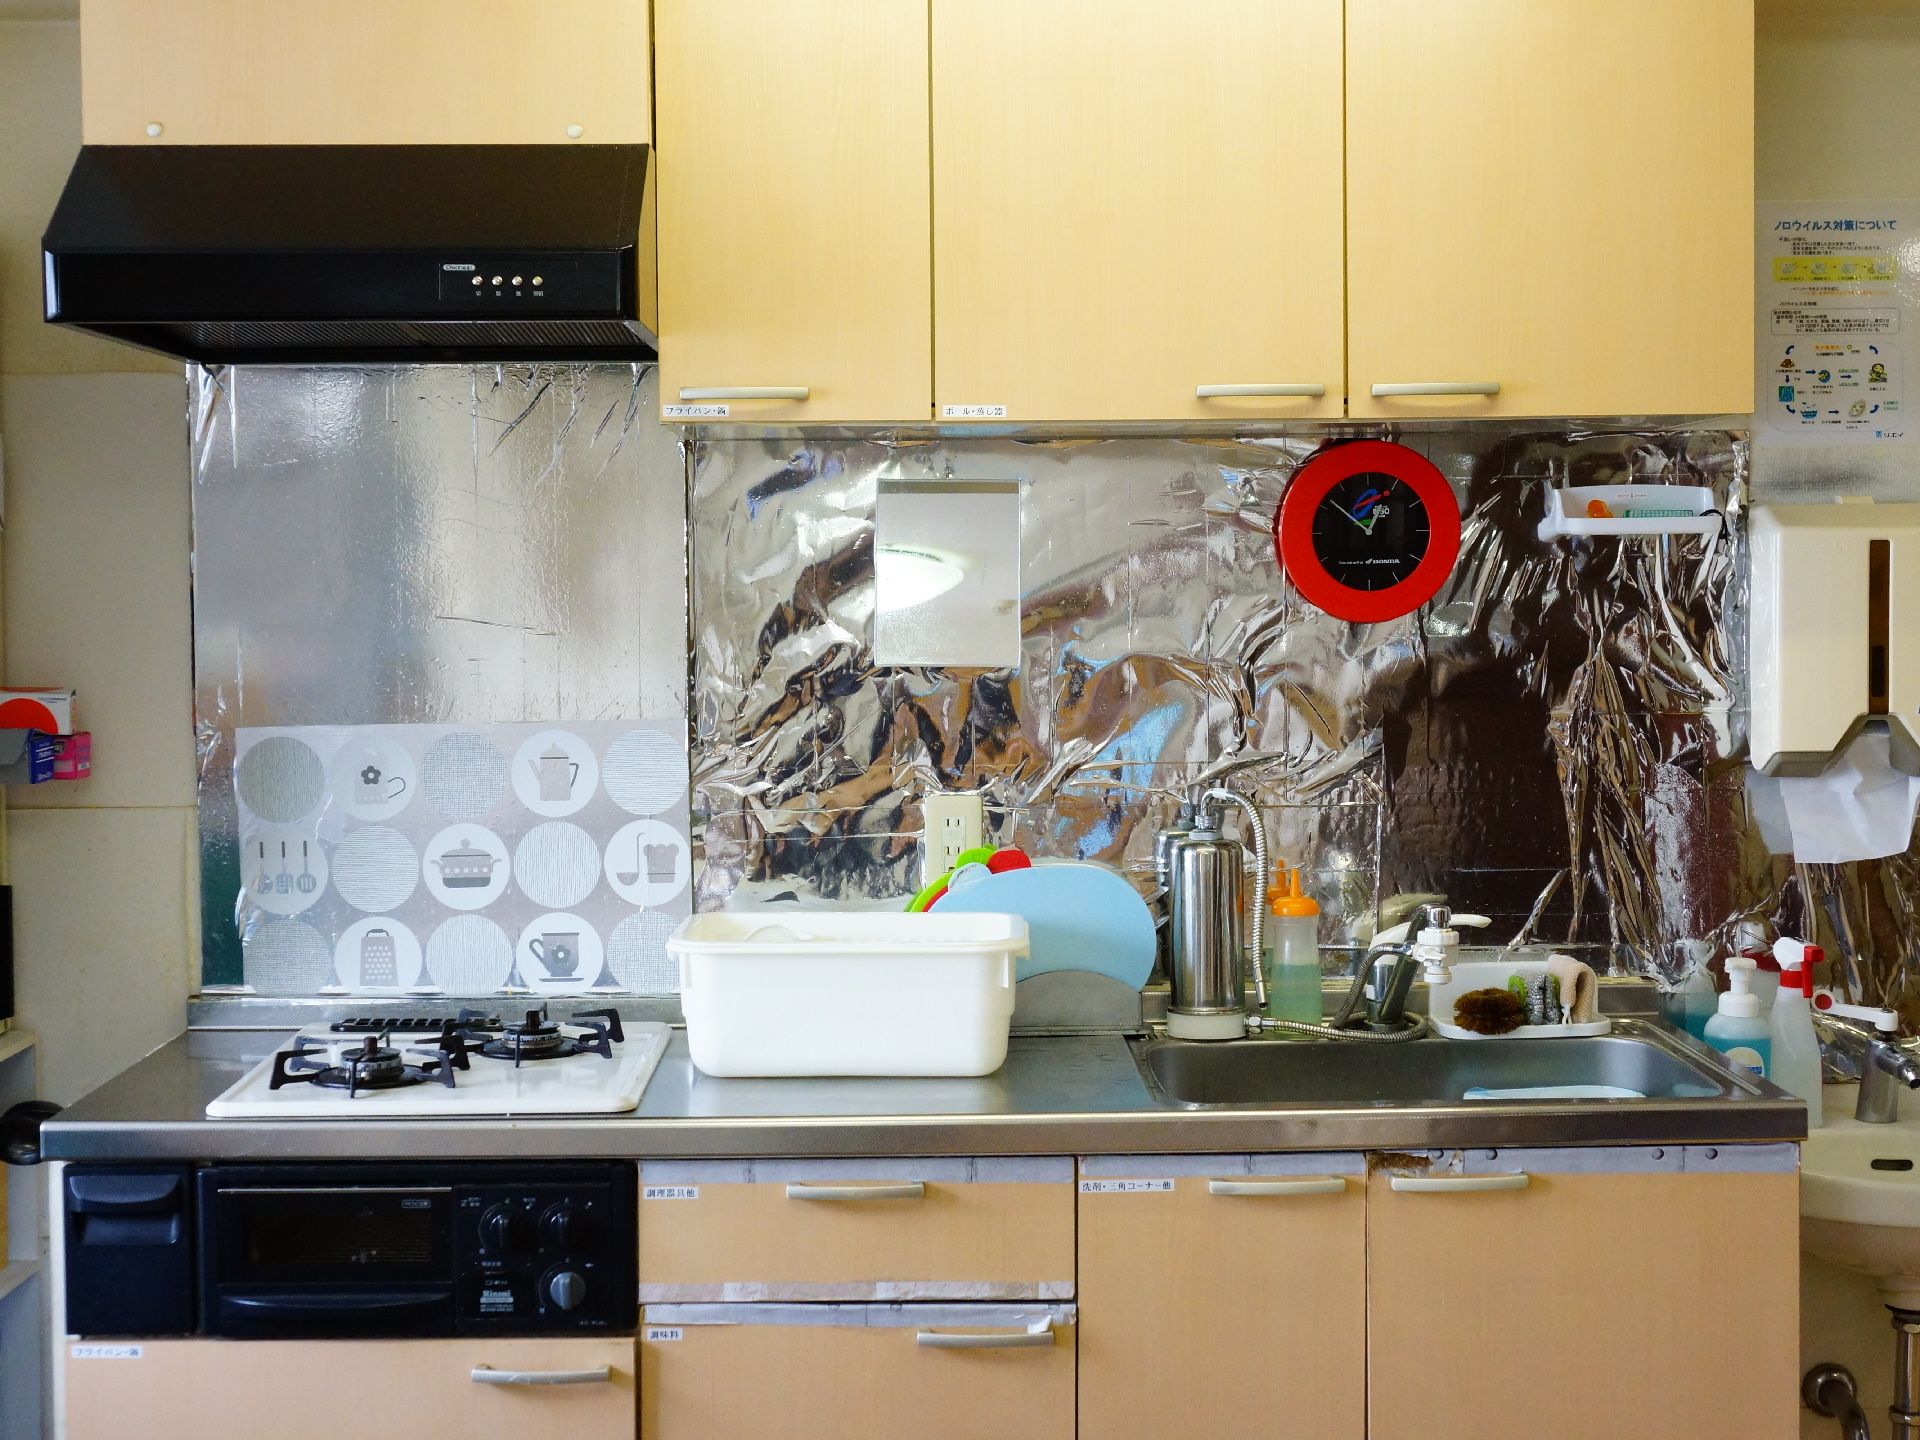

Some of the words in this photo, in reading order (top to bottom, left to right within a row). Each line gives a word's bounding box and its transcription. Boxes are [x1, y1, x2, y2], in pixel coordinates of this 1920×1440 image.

[1774, 219, 1897, 231] ノロウイルス対策について
[1082, 1181, 1172, 1192] 洗剤・三角コーナー他
